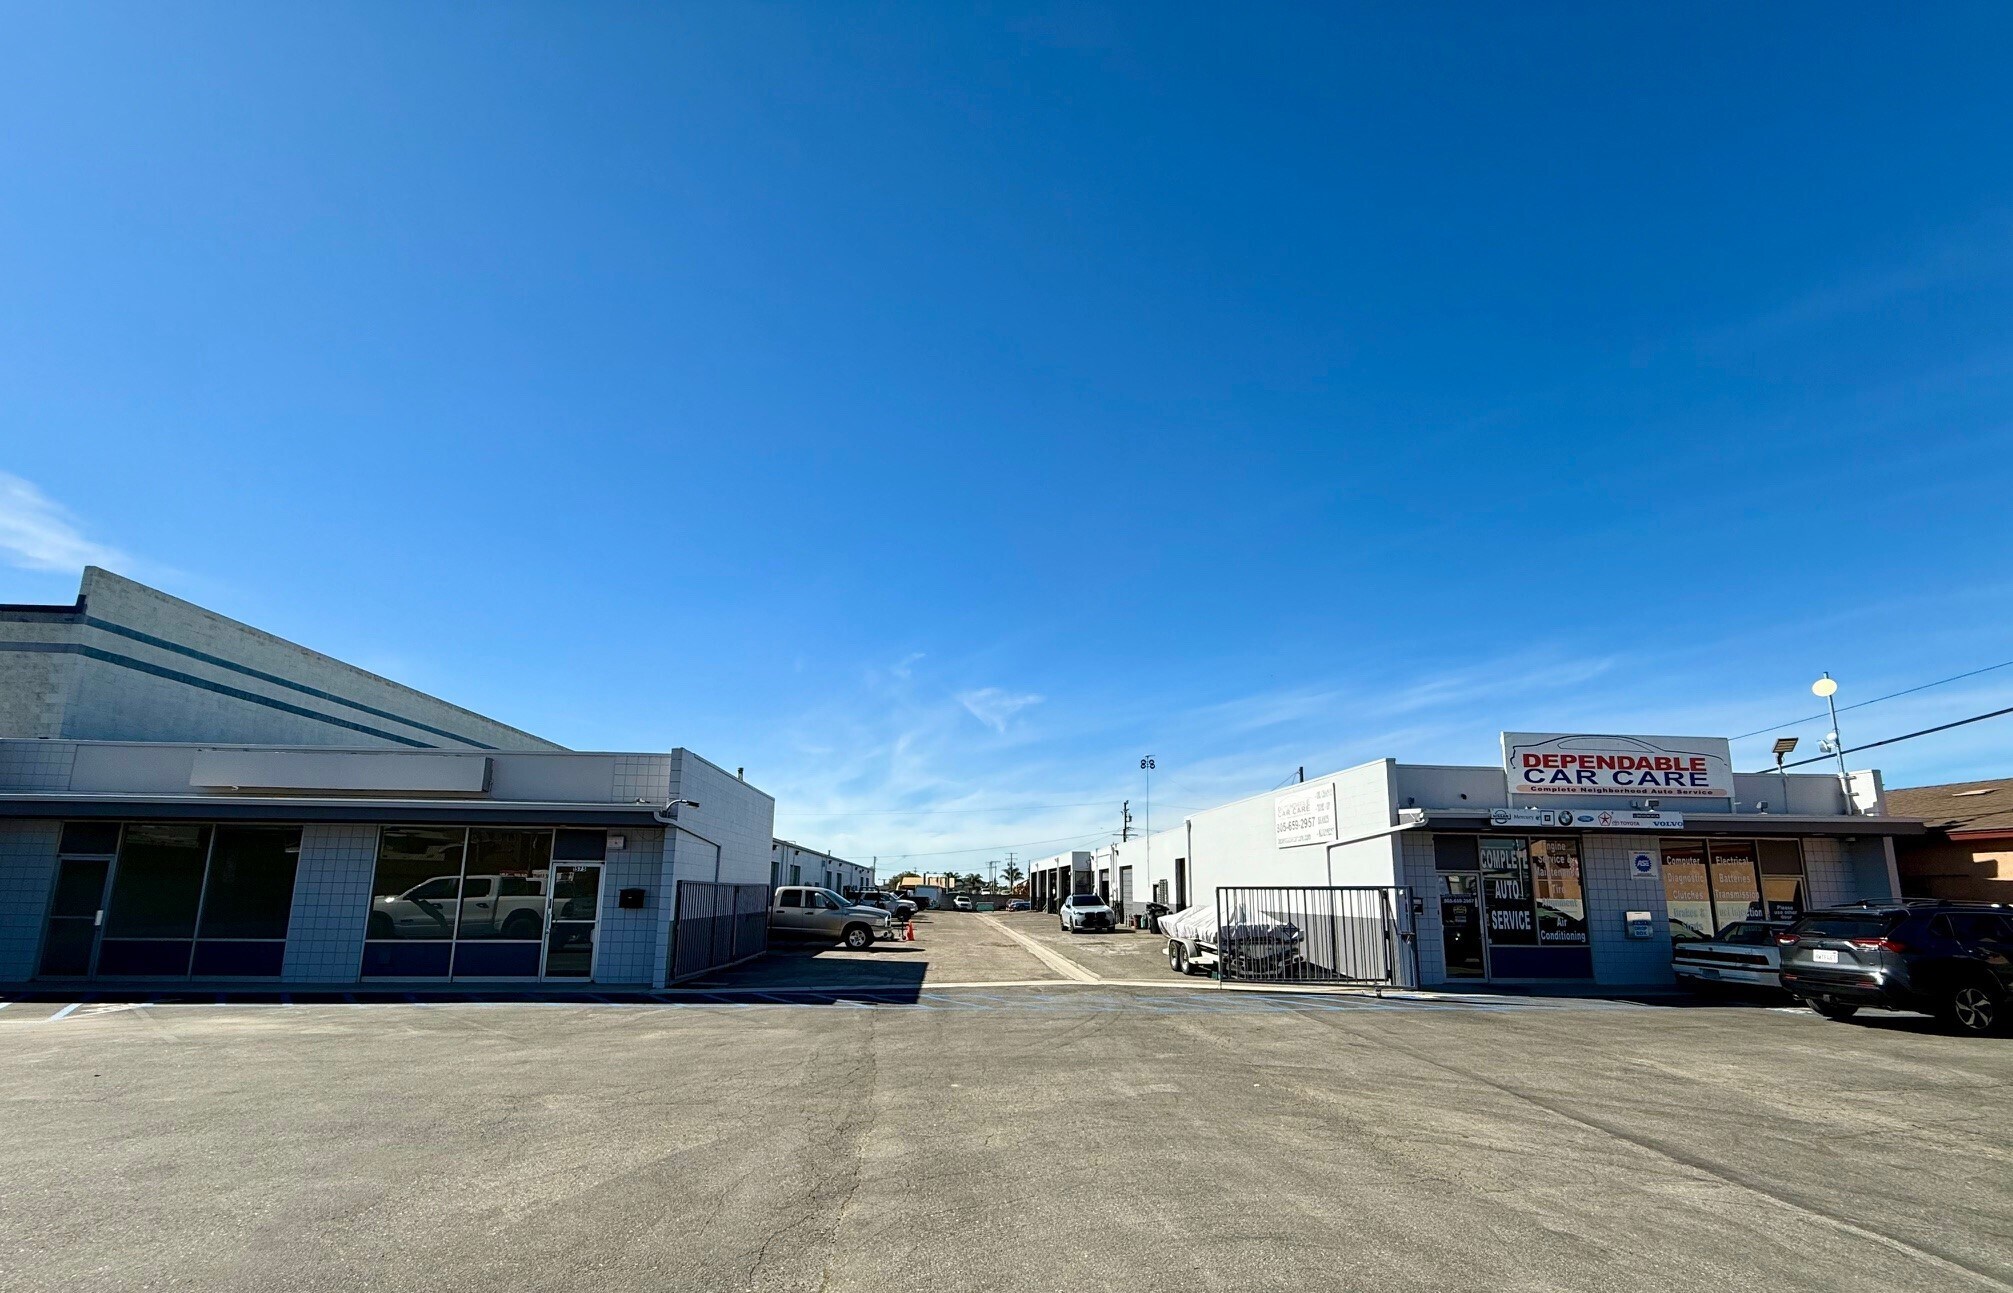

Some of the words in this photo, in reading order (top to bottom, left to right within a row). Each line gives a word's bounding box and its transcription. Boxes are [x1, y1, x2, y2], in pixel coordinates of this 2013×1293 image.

[1522, 753, 1707, 772] DEPENDABLE
[1523, 769, 1599, 785] CAR
[1612, 771, 1710, 787] CARE
[1580, 787, 1648, 795] Neighborhood
[1292, 804, 1311, 815] CARE
[1542, 841, 1566, 853] ngine
[1666, 855, 1701, 867] Computer
[1715, 856, 1749, 866] Electrical
[1667, 872, 1704, 884] Diagnostic
[1718, 873, 1751, 883] Batteries
[1495, 880, 1520, 900] AUTO
[1672, 890, 1704, 900] Clutches
[1714, 889, 1760, 900] Transmission
[1491, 910, 1532, 930] SERVICE
[1556, 916, 1567, 927] Air
[1540, 930, 1586, 942] Conditioning
